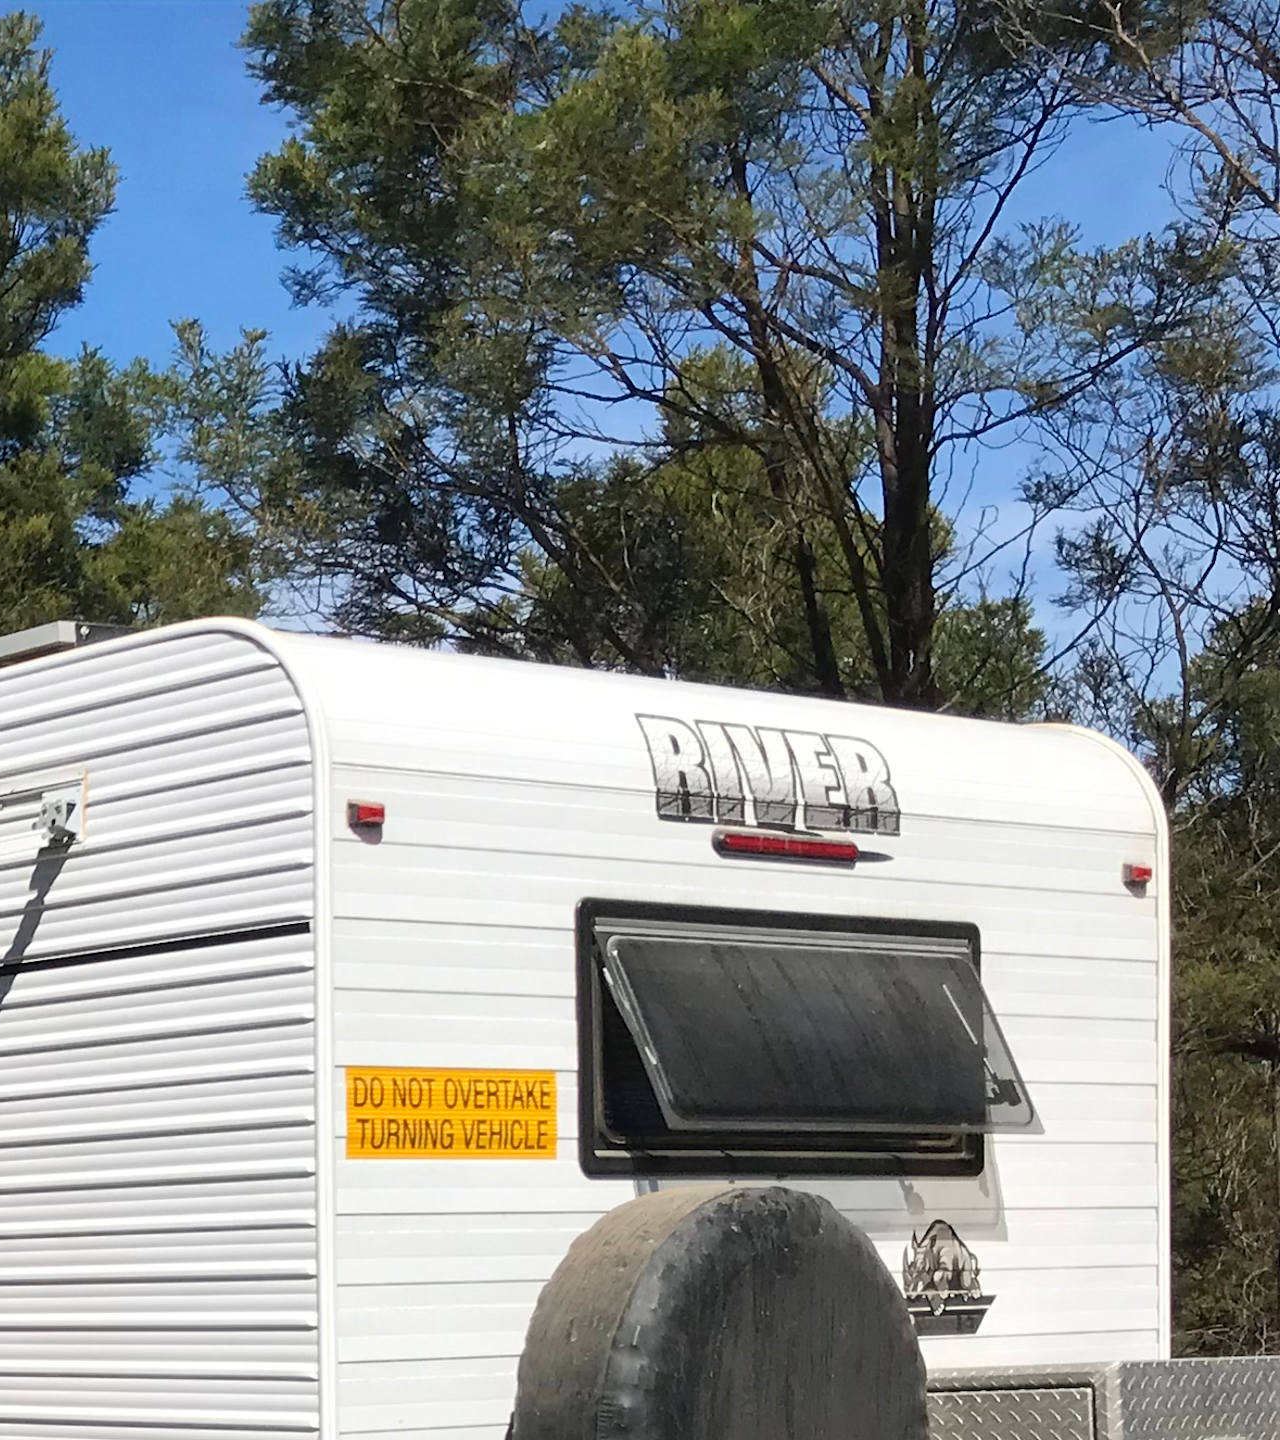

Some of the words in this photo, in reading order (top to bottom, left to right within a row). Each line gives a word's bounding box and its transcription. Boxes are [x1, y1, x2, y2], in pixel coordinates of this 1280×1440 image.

[635, 713, 901, 836] RIVER
[352, 1077, 385, 1108] DO
[392, 1077, 435, 1109] NOT
[443, 1078, 552, 1110] OVERTAKE
[357, 1118, 454, 1150] TURNING
[461, 1119, 548, 1150] VEHICLE
